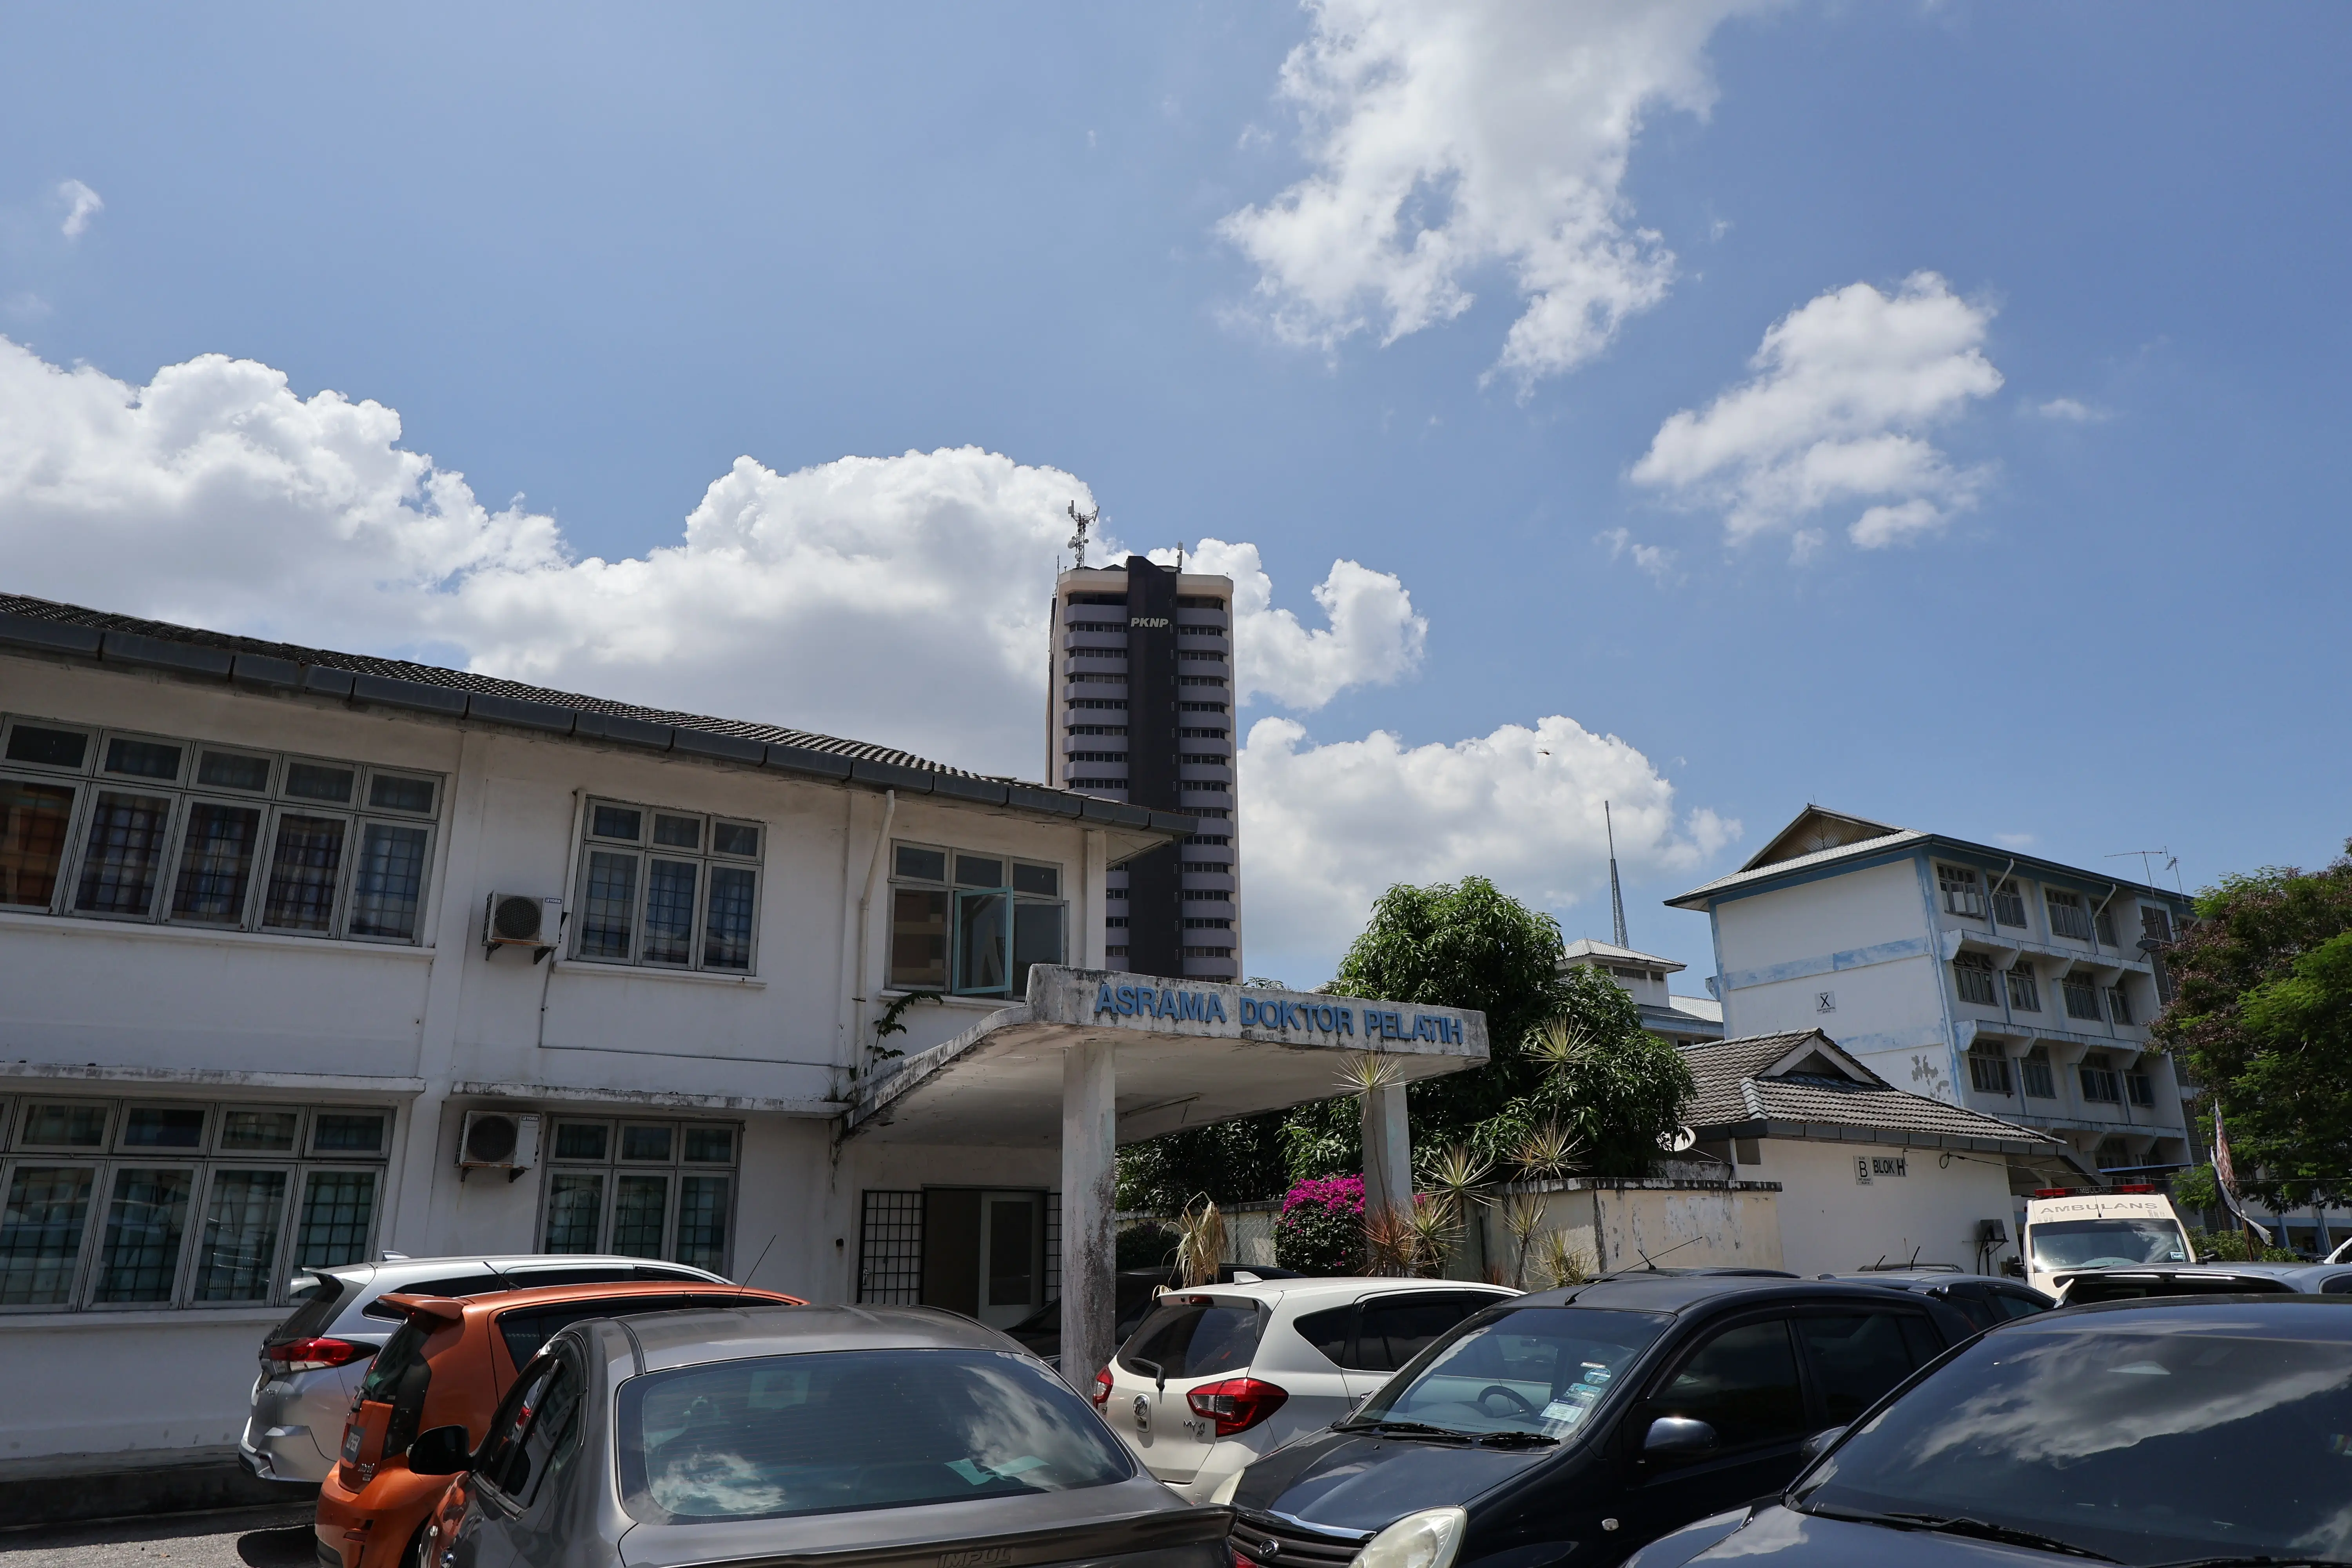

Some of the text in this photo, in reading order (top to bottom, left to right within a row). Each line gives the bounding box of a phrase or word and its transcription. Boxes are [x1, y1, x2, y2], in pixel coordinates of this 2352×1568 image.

[1131, 618, 1169, 628] PKNP
[1820, 995, 1830, 1008] X
[1094, 984, 1464, 1045] ASRAMA DOKTOR PELATIH
[1859, 1161, 1868, 1177] B
[1873, 1159, 1905, 1176] BLOK H
[2040, 1203, 2158, 1214] AMBULANS
[937, 1548, 1011, 1568] IMPUL
